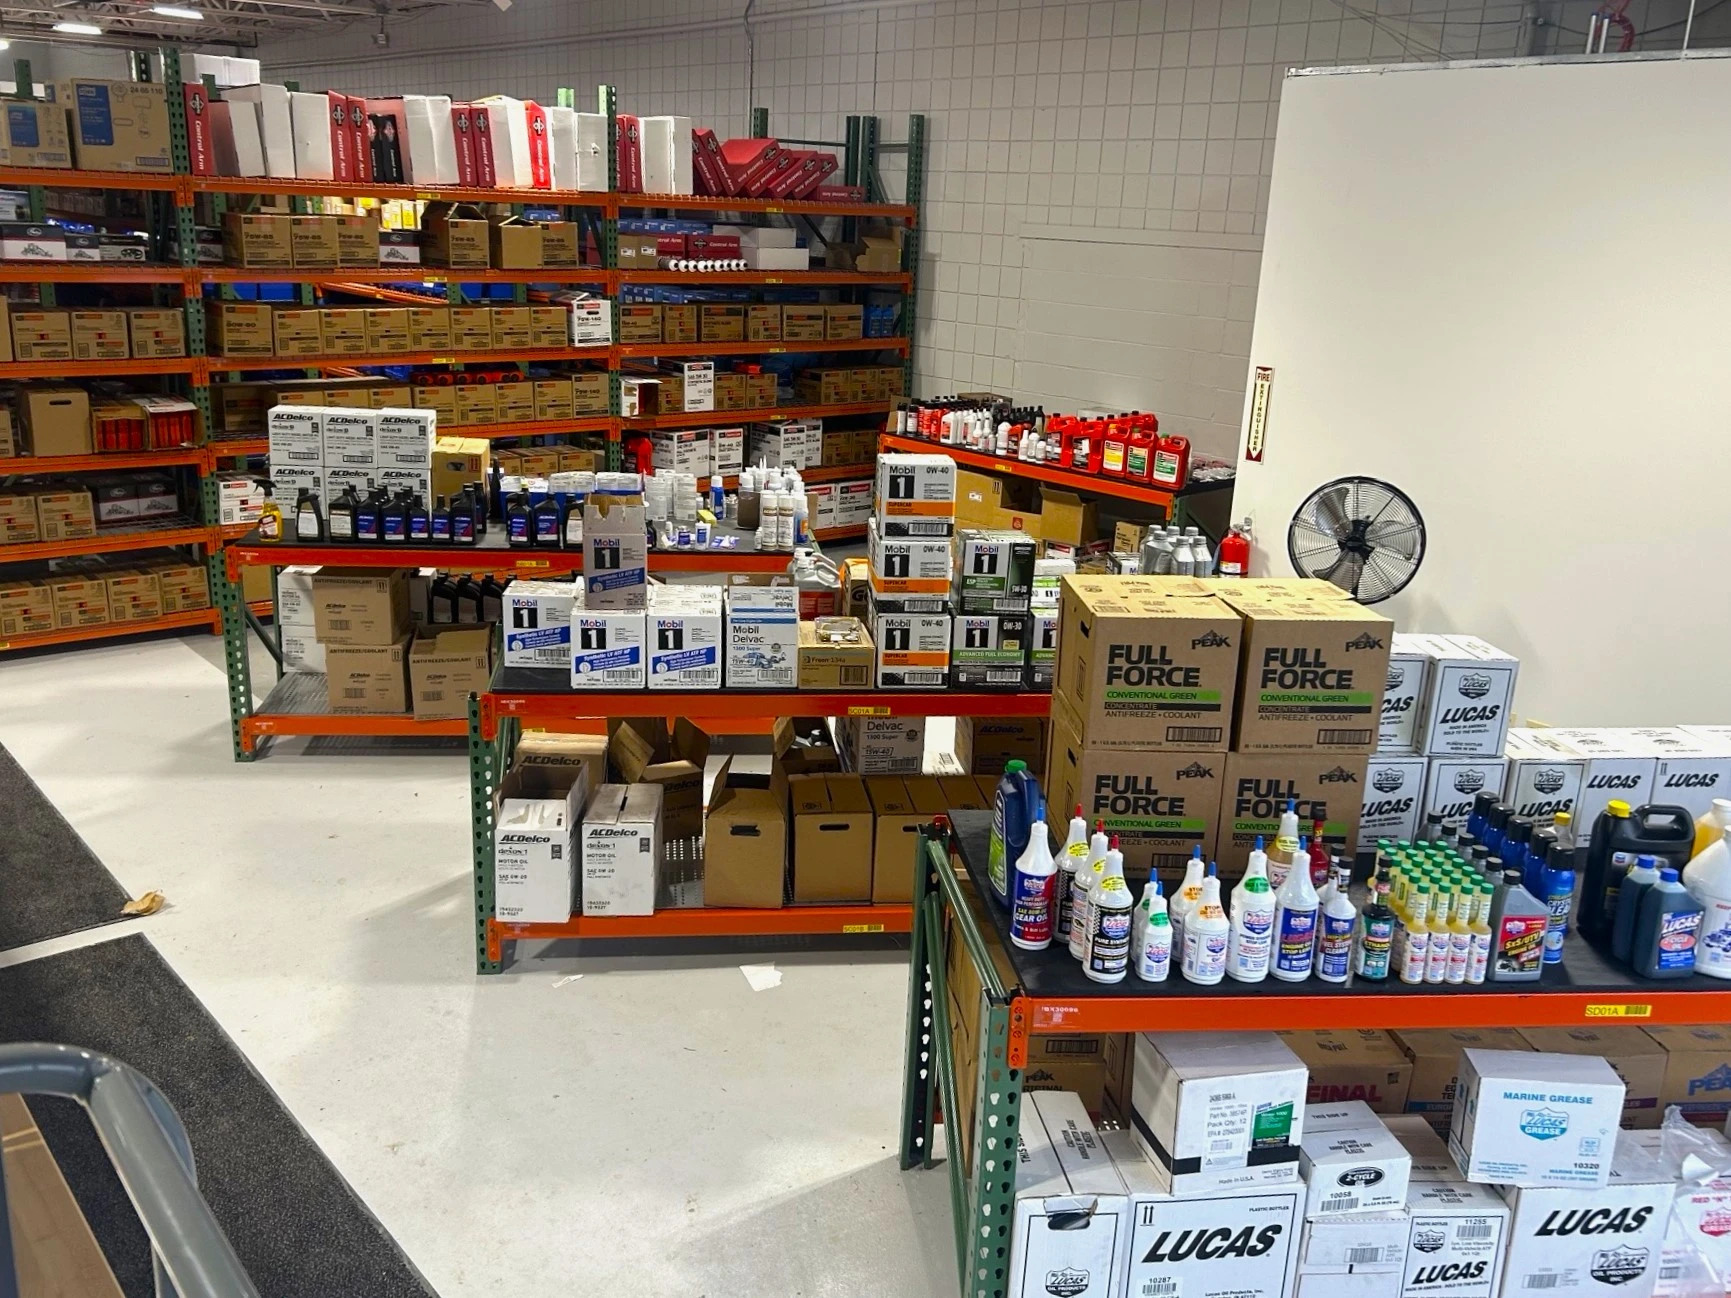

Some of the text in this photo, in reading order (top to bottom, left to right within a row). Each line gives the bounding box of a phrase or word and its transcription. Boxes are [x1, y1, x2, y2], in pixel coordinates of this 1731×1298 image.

[195, 120, 204, 152] Control
[337, 130, 346, 161] Control
[356, 132, 364, 161] Control
[716, 156, 730, 178] Control
[1257, 372, 1270, 382] FIRE
[274, 413, 314, 421] ACDelco
[328, 416, 368, 424] ACDelco
[381, 416, 421, 424] ACDelco
[1252, 383, 1265, 452] EXTINGUISHER
[890, 466, 949, 474] Mobil 0W-40
[897, 476, 905, 498] 1
[594, 538, 620, 547] Mobil
[885, 545, 910, 554] Mobil
[975, 544, 999, 554] Mobil
[602, 550, 611, 568] 1
[981, 554, 990, 574] 1
[892, 556, 900, 577] 1
[512, 599, 538, 607] Mobil
[520, 609, 529, 628] 1
[580, 619, 606, 628] Mobil
[657, 620, 684, 628] Mobil
[886, 619, 911, 628] Mobil
[966, 620, 990, 628] Mobil
[733, 626, 760, 634] Mobil
[588, 630, 598, 649] 1
[665, 630, 675, 649] 1
[732, 634, 765, 644] Delvac
[893, 629, 900, 650] 1
[973, 629, 982, 648] 1
[1192, 636, 1232, 650] PEAK
[1345, 638, 1384, 652] PEAK
[584, 652, 606, 662] Synthetic
[660, 653, 683, 662] Synthetic
[1108, 644, 1173, 666] FULL
[1263, 648, 1328, 668] FULL
[1106, 666, 1202, 688] FORCE
[1260, 669, 1354, 690] FORCE
[1106, 691, 1198, 700] CONVENTIONAL GREEN
[1260, 694, 1348, 702] CONVENTIONAL GREEN
[1258, 705, 1310, 713] CONCENTRATE
[1382, 696, 1414, 714] CAS
[1105, 710, 1202, 720] ANTIFREEZE COOLANT
[1258, 714, 1352, 722] ANTIFREEZE COOLANT
[1440, 704, 1500, 724] LUCAS
[866, 720, 903, 732] Delvac
[522, 755, 581, 766] ACDelco
[1176, 767, 1214, 780] PEAK
[1318, 772, 1358, 784] PEAK
[1095, 774, 1158, 796] FULL
[1587, 774, 1642, 790] LUCAS
[1664, 772, 1720, 788] LUCAS
[1237, 778, 1300, 798] FULL
[1093, 796, 1186, 817] FORCE
[1361, 798, 1414, 818] LUCAS
[1518, 798, 1573, 818] LUCAS
[1094, 820, 1182, 828] CNVENTIONAL GREEN
[501, 834, 551, 843] ACDelco
[590, 828, 638, 837] ACDelco
[1014, 914, 1034, 922] GEAR
[1661, 915, 1702, 934] LUCAS
[1586, 1007, 1619, 1016] SD01A
[1026, 1072, 1055, 1083] PEAK
[1688, 1074, 1731, 1096] PEA
[1504, 1092, 1593, 1104] MARINE GREASE
[1526, 1116, 1566, 1127] LUCAS
[1524, 1126, 1562, 1136] GREASE
[1534, 1206, 1654, 1237] LUCAS
[1141, 1224, 1283, 1264] LUCAS
[1600, 1258, 1647, 1270] LUCAS
[1412, 1260, 1488, 1284] LUCAS
[1050, 1276, 1086, 1285] LUCAS
